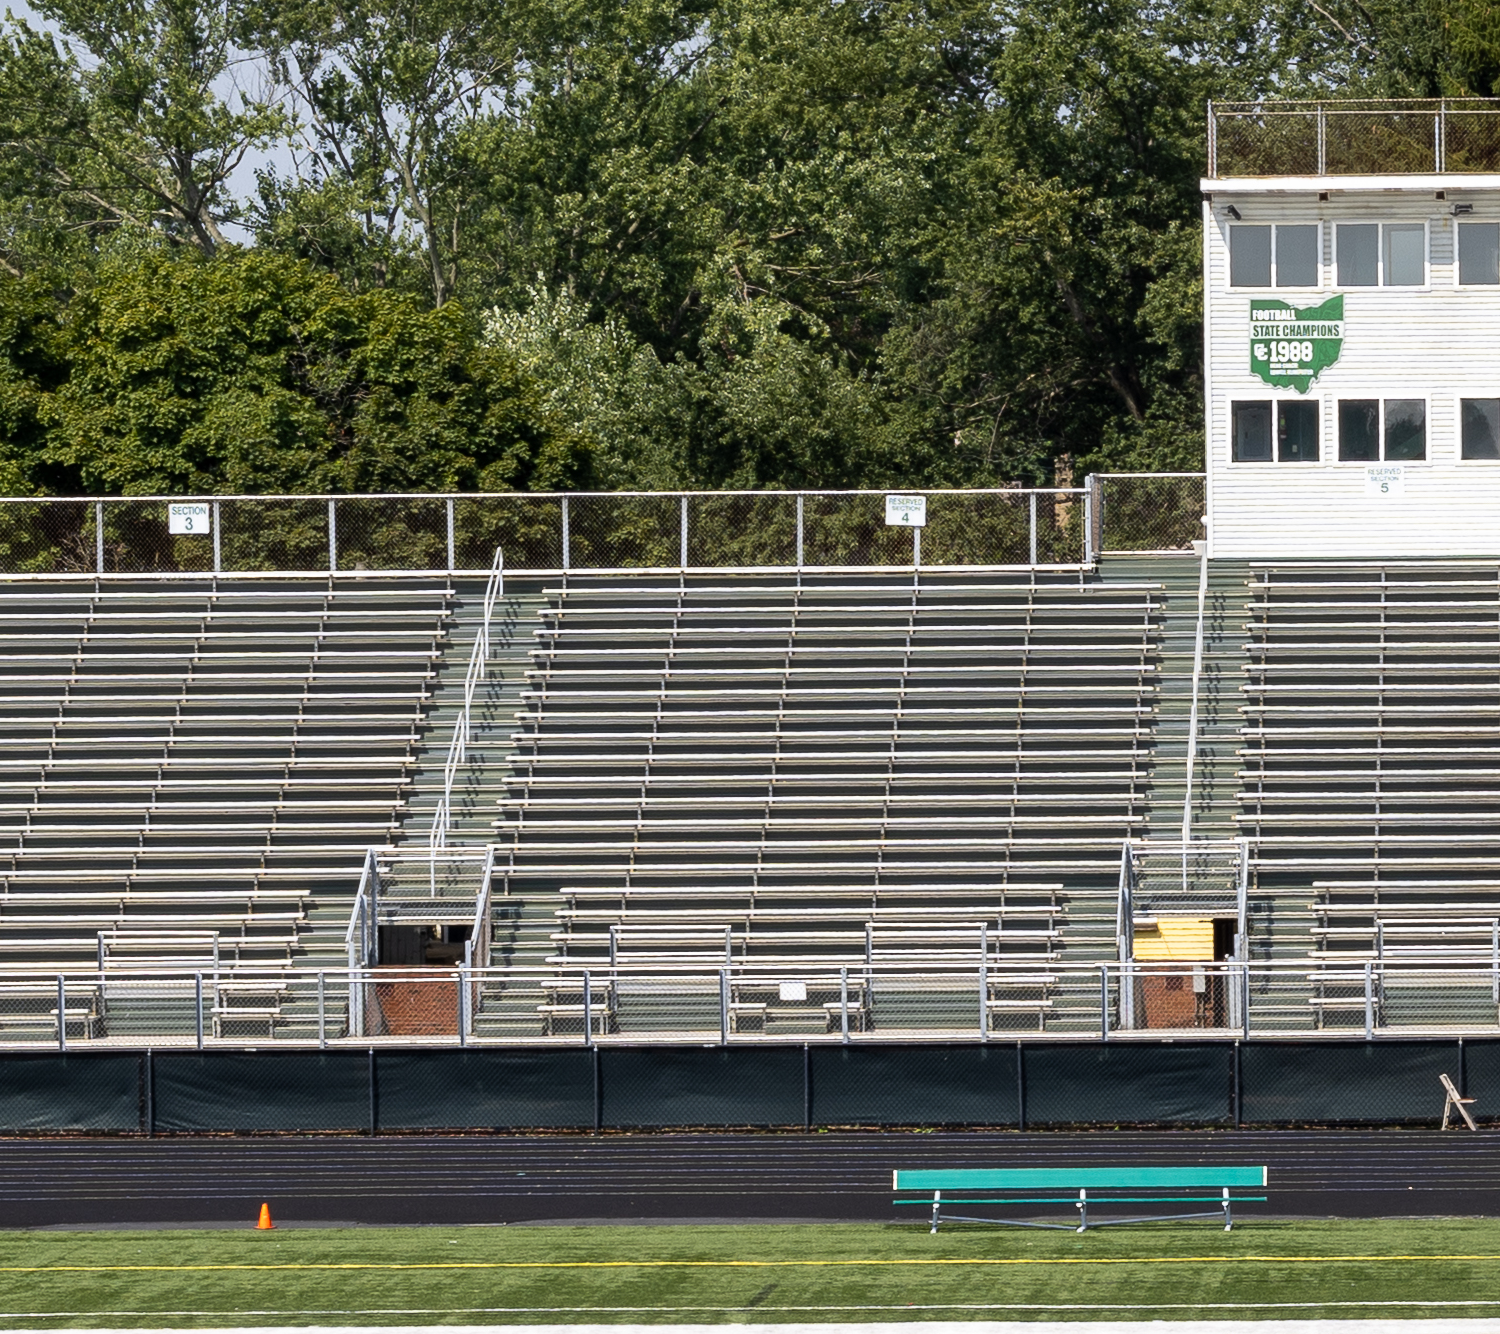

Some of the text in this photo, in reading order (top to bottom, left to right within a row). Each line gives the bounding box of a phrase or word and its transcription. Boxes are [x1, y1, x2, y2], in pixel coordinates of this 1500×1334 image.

[1252, 309, 1296, 320] FOOTBALL
[1253, 324, 1340, 337] STATE CHAMPIONS
[1269, 341, 1313, 362] 1988
[1367, 468, 1401, 476] RESERVED
[1380, 482, 1389, 493] 5
[888, 497, 923, 505] RESERVED
[171, 505, 207, 515] SECTION
[901, 512, 909, 523] 4
[184, 517, 193, 531] 3
